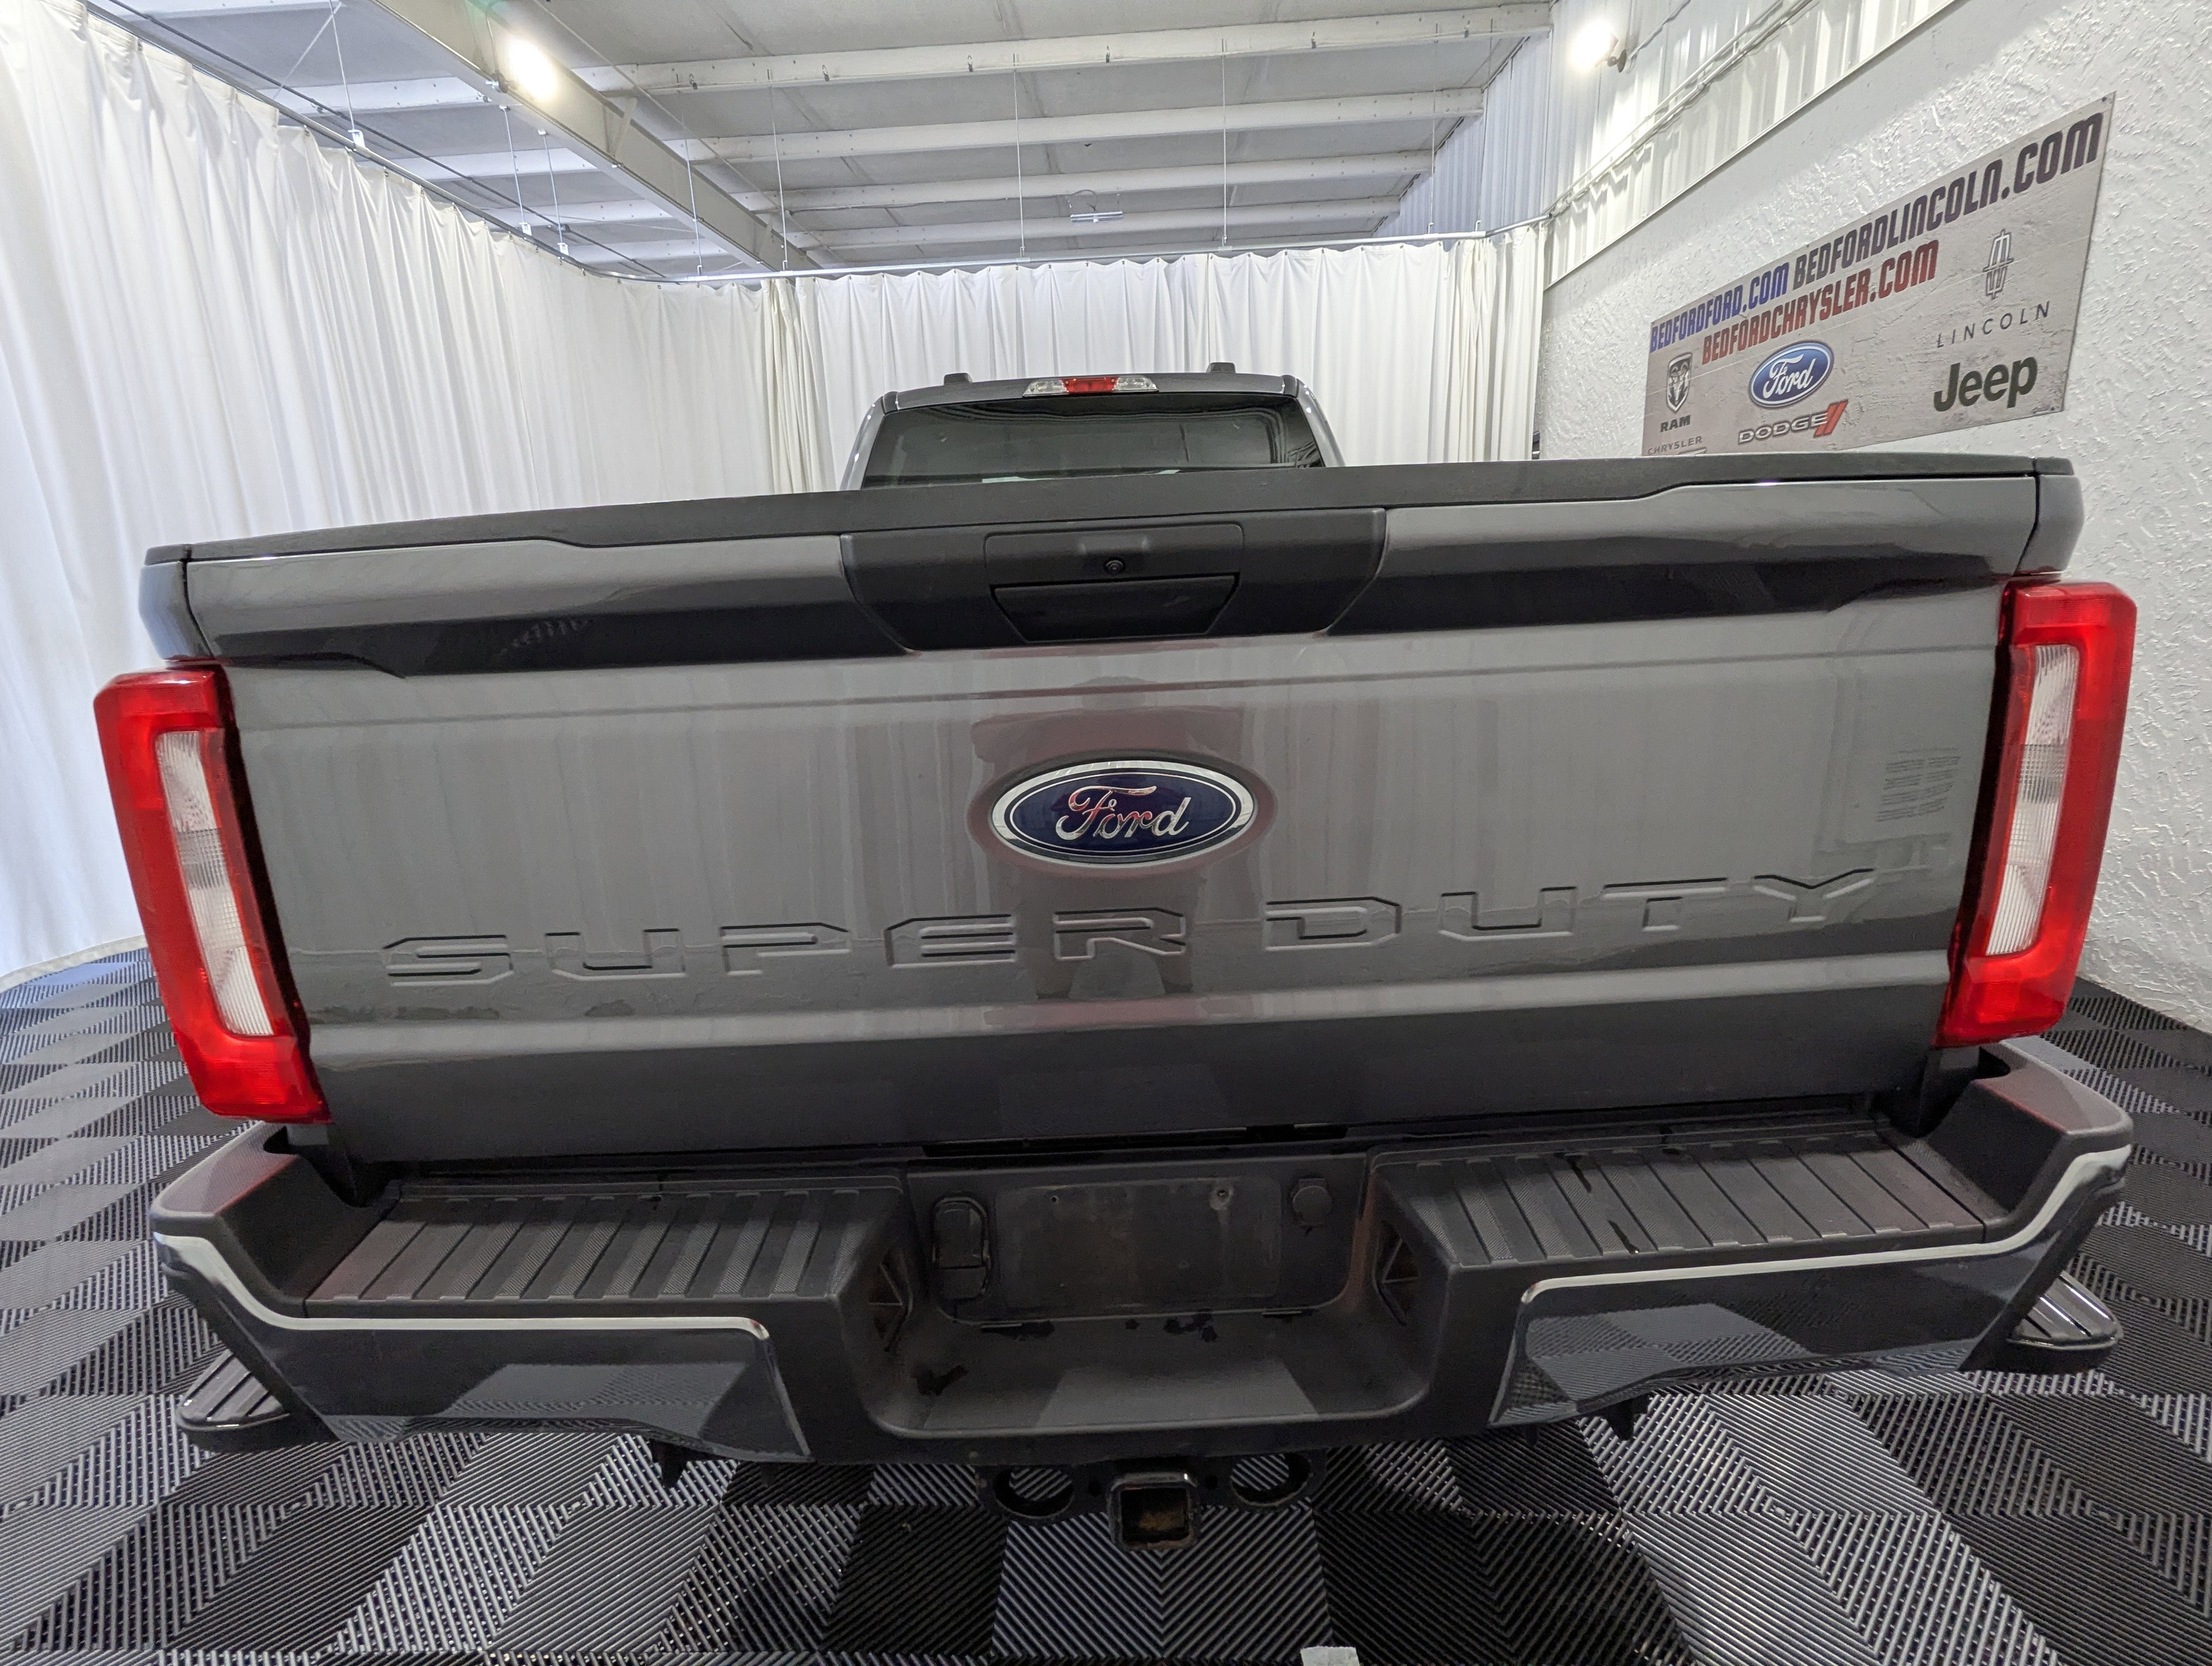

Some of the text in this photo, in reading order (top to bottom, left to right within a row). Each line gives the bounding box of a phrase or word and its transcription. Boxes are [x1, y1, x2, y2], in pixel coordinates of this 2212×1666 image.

[1650, 113, 2104, 353] BEDFORDFORD.COM BEDFORDLINCOLN.COM
[1702, 240, 1939, 366] BEDFORDCHRYSLER.COM
[1937, 301, 2050, 348] LINCOLN
[1762, 355, 1814, 402] Ford
[1933, 356, 2037, 412] Jeep
[1648, 435, 1703, 456] CHRYSLER
[1660, 415, 1691, 433] RAM
[1738, 411, 1828, 445] DODGE
[1056, 785, 1192, 841] Ford
[382, 868, 1875, 988] SUPER DUTY
